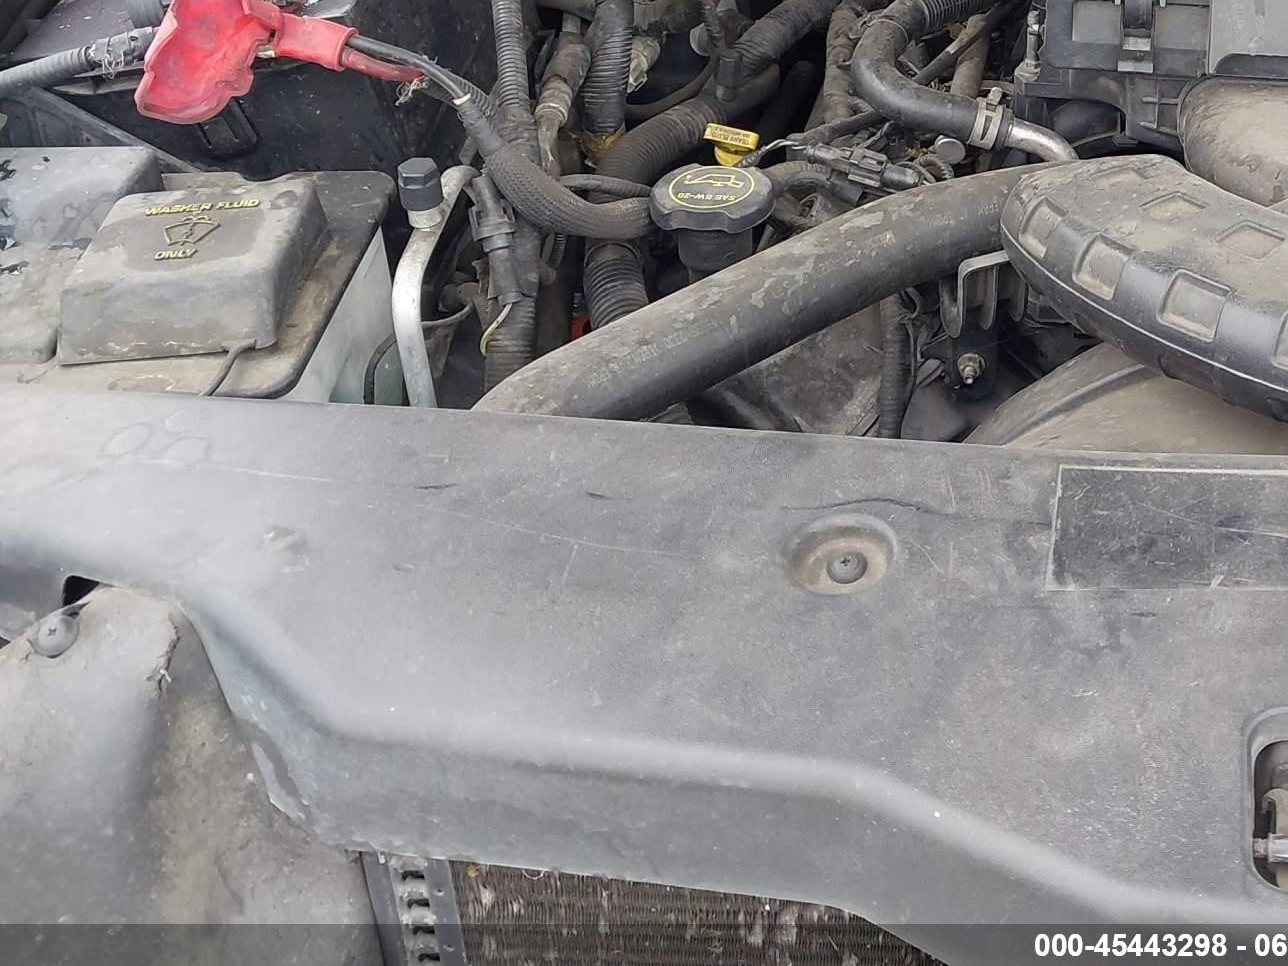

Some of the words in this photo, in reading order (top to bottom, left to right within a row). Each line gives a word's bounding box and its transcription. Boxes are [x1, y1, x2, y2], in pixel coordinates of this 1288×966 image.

[145, 202, 213, 216] WASHER
[215, 198, 261, 210] FLUID
[154, 248, 198, 260] ONLY
